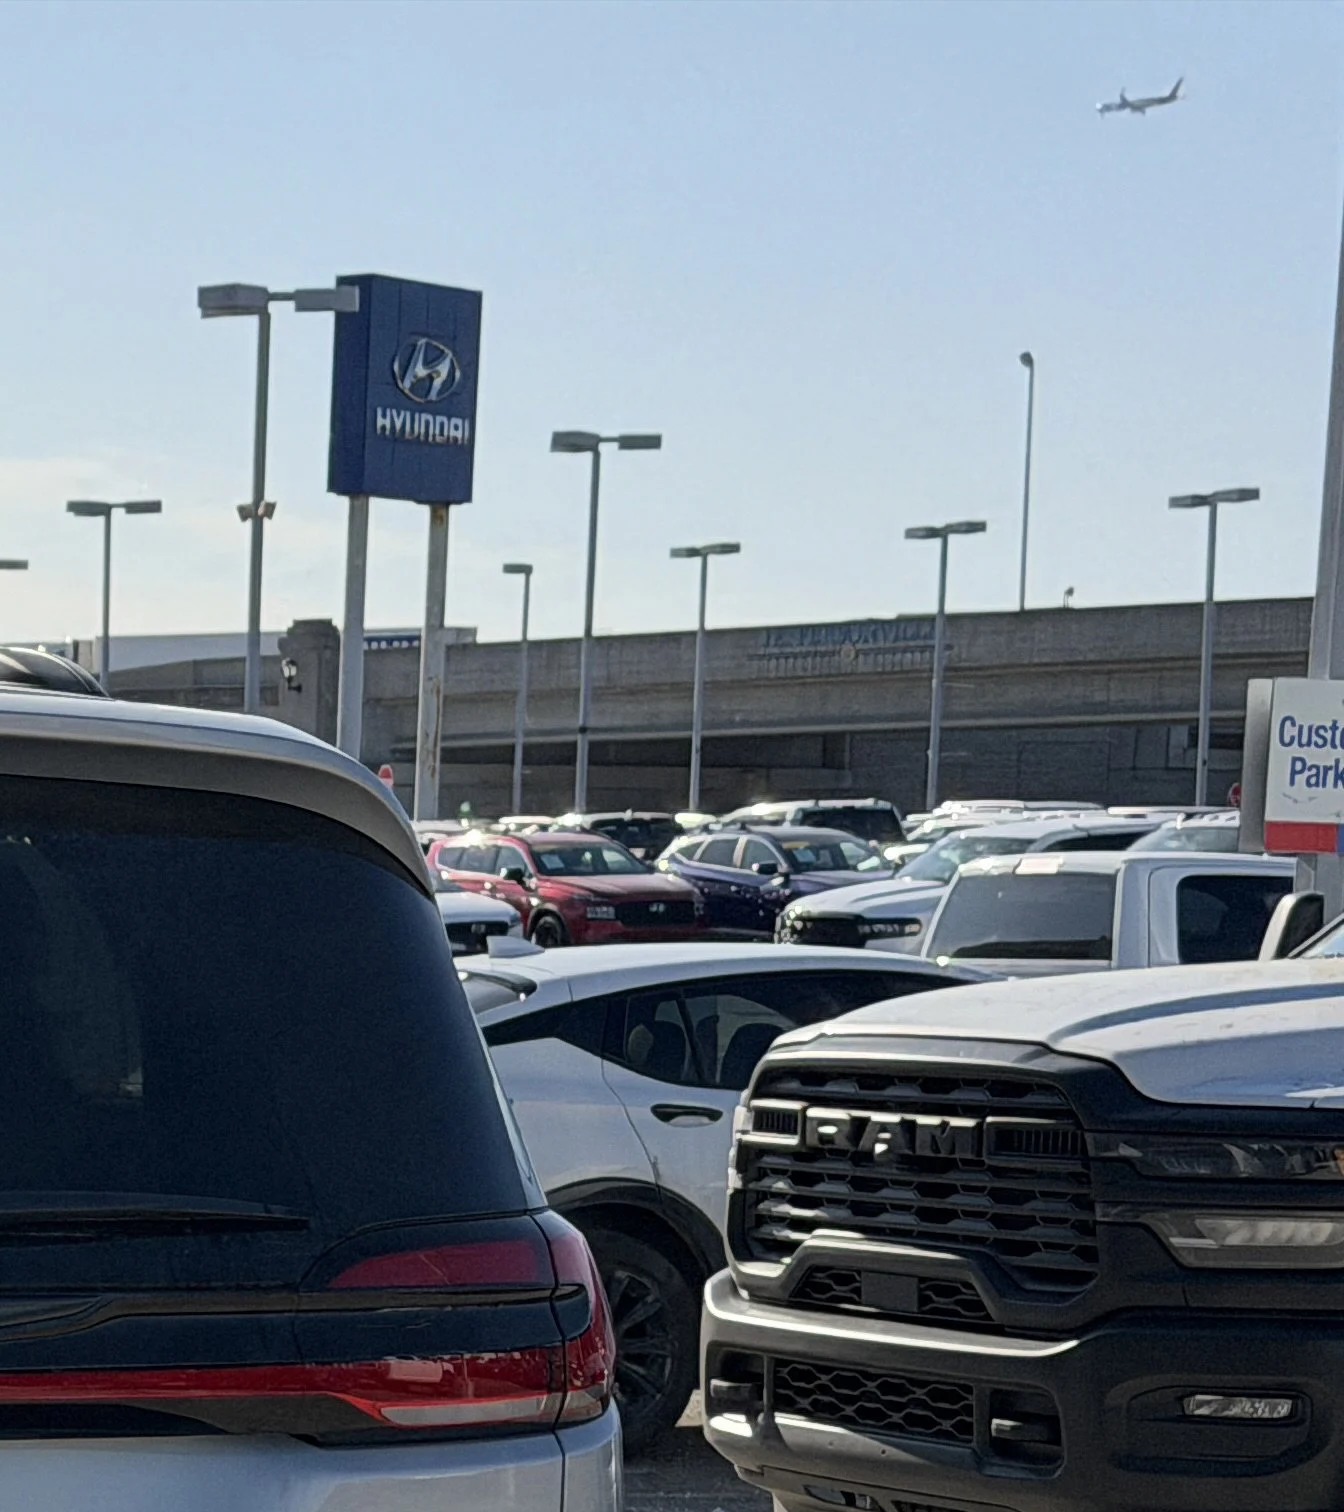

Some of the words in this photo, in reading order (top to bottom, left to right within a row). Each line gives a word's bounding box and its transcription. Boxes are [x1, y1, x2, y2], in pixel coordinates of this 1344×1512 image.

[376, 407, 469, 445] HYUNDAI
[1278, 715, 1344, 750] Cust
[806, 1107, 984, 1159] RAM
